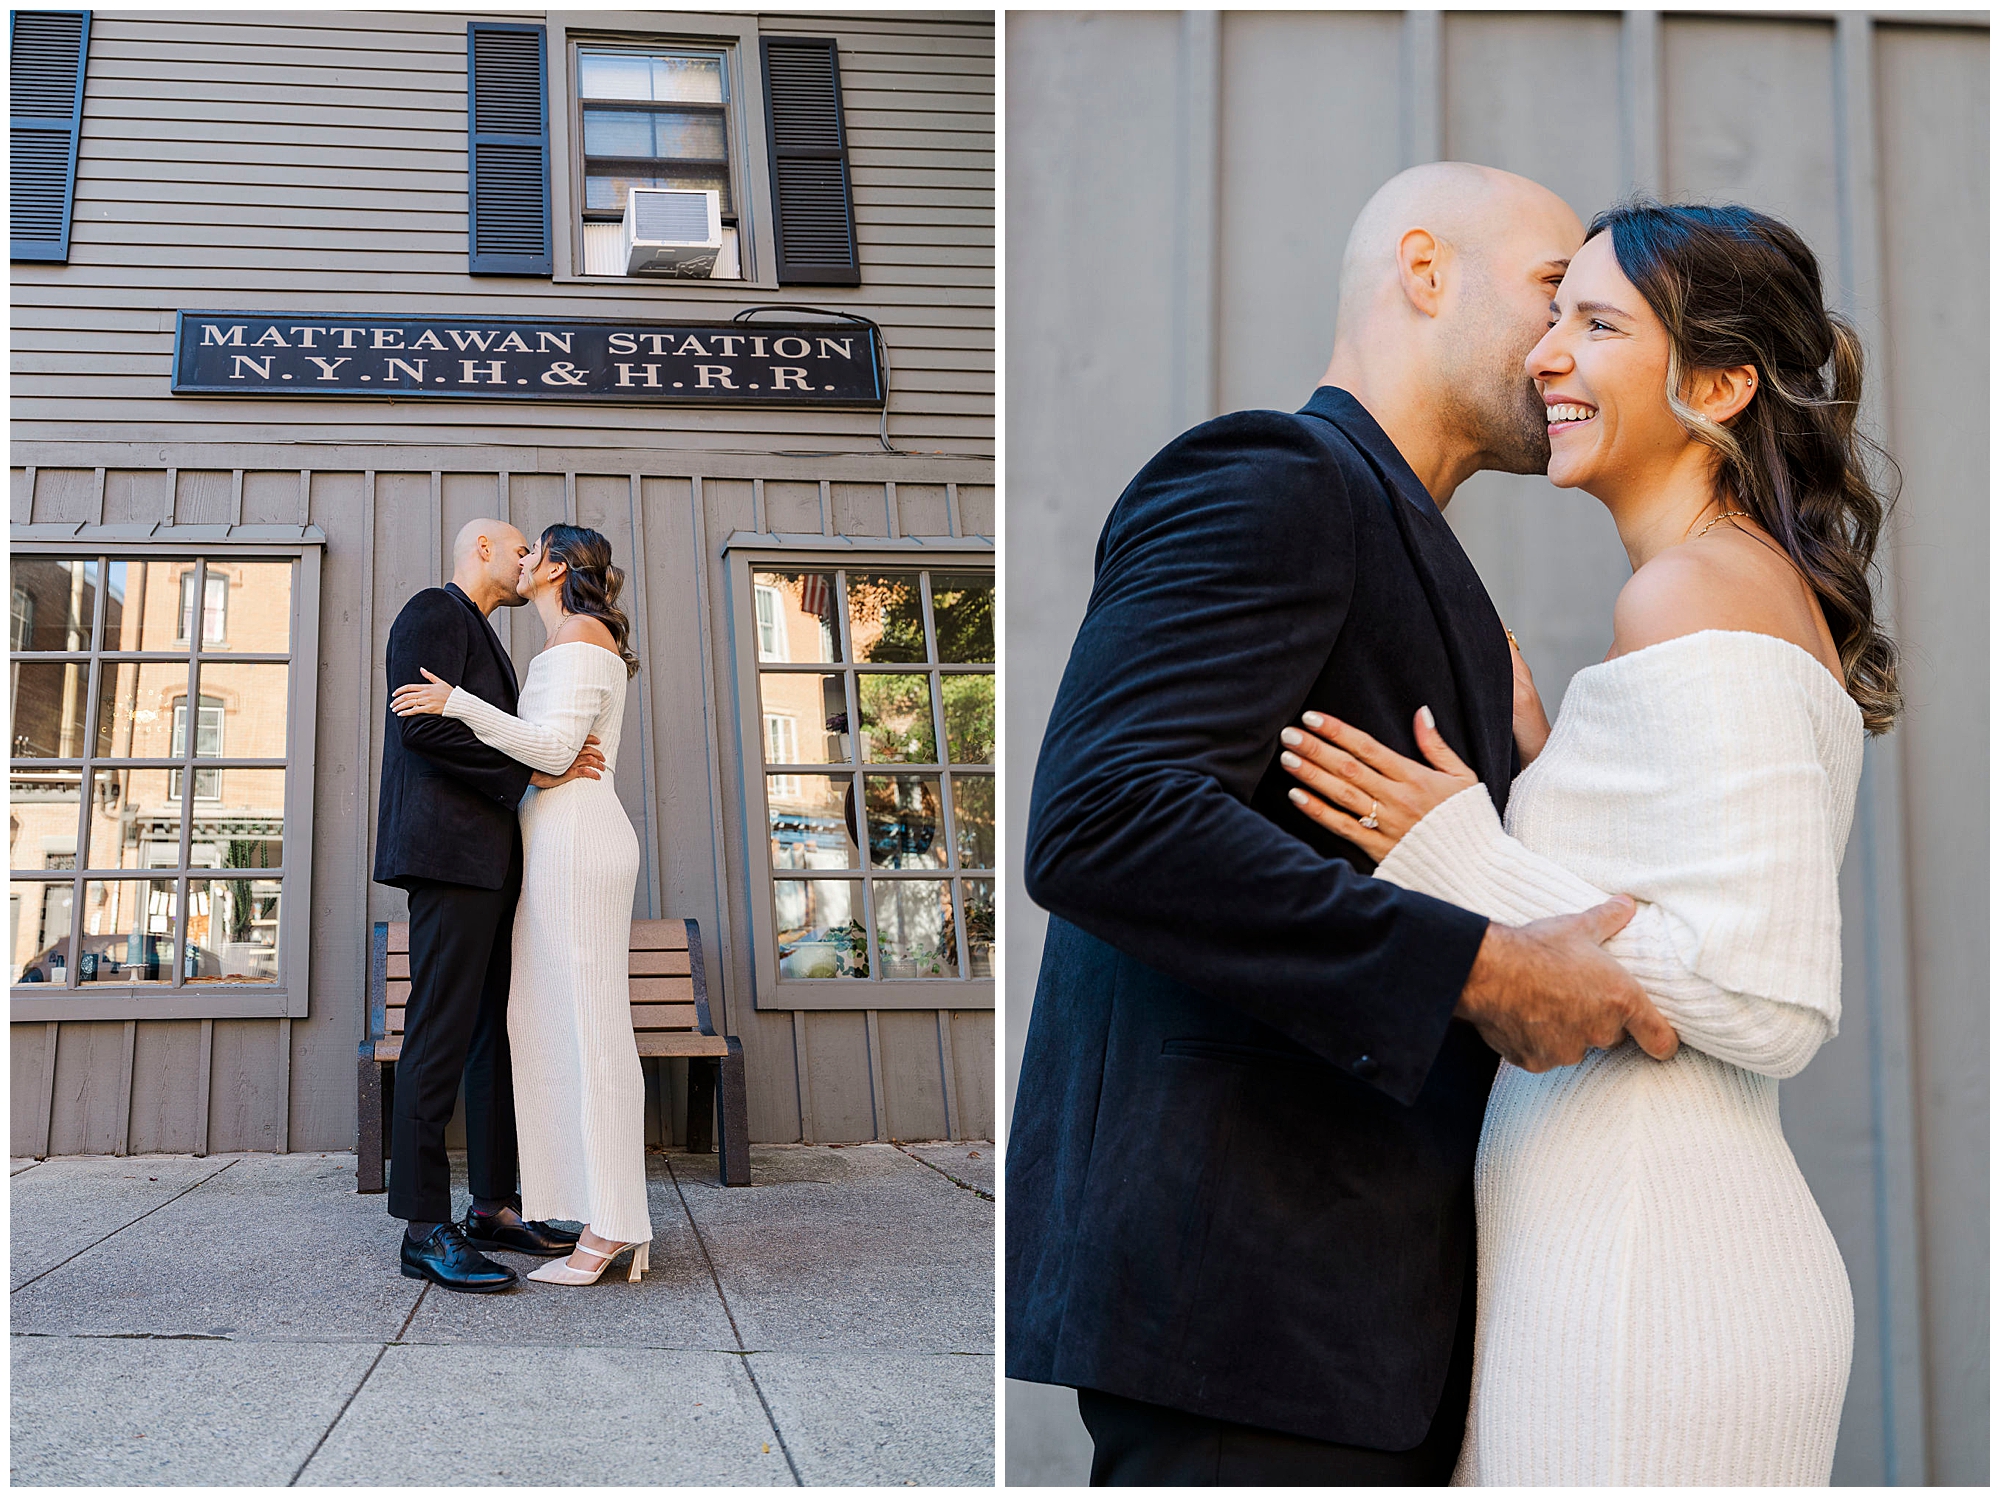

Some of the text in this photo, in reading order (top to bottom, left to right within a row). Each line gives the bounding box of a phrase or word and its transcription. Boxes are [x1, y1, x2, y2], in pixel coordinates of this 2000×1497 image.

[200, 324, 854, 360] MATTEAWAN STATION
[613, 363, 836, 391] H.R.R.
